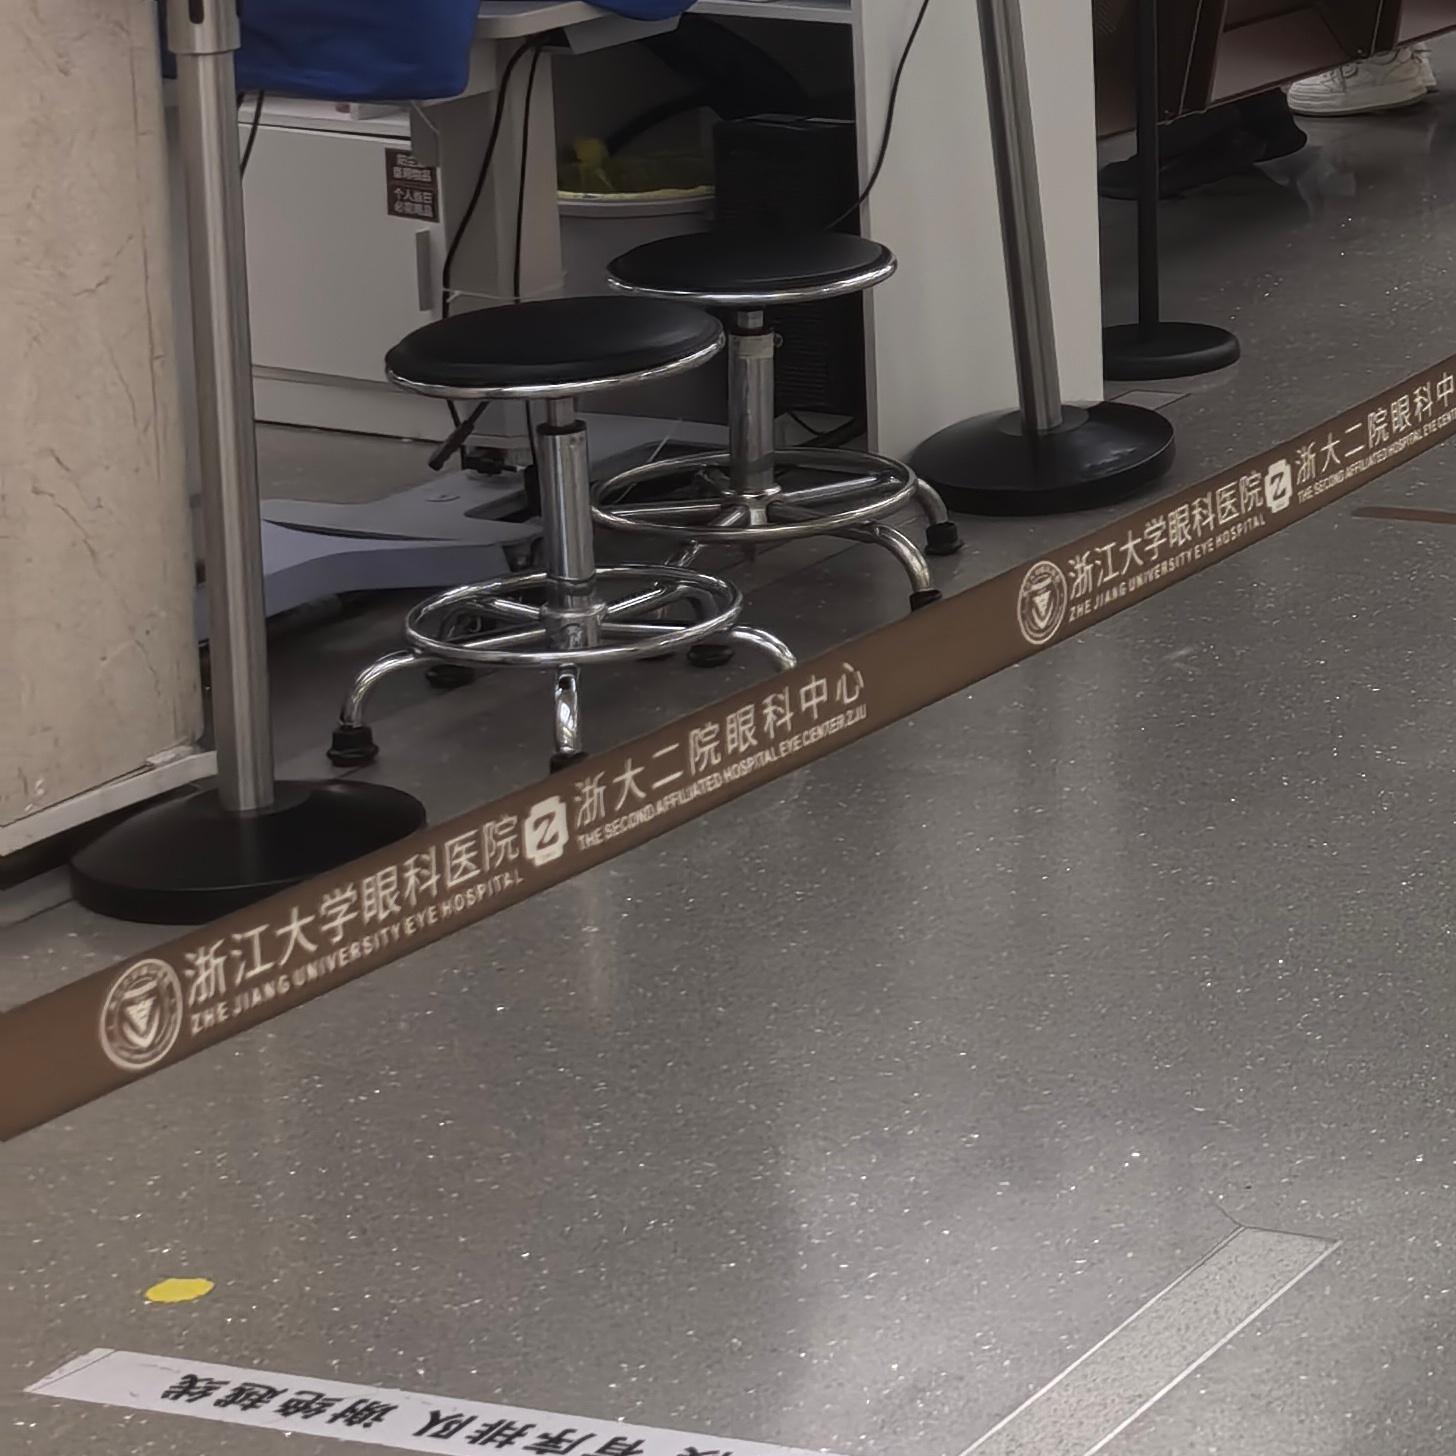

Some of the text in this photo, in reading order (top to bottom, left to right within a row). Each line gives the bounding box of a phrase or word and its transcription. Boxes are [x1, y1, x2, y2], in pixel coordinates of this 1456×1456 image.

[1068, 469, 1265, 600] 浙江大学眼科医院
[1128, 551, 1193, 593] UNIVERSITY
[1194, 540, 1216, 560] EYE
[1215, 512, 1267, 548] HOSPITAL
[183, 813, 520, 1006] 浙江大学眼科医院
[574, 662, 865, 828] 浙大二院眼科中心
[190, 1005, 232, 1037] ZHE
[234, 974, 291, 1016] JIANG
[294, 924, 403, 987] UNIVERSITY
[404, 903, 440, 936] EYE
[441, 869, 525, 920] HOSPITAL
[578, 825, 605, 851] THE
[723, 750, 778, 784] HOSPITAL
[779, 735, 803, 758] EYE
[160, 1371, 398, 1432] 谢绝越线
